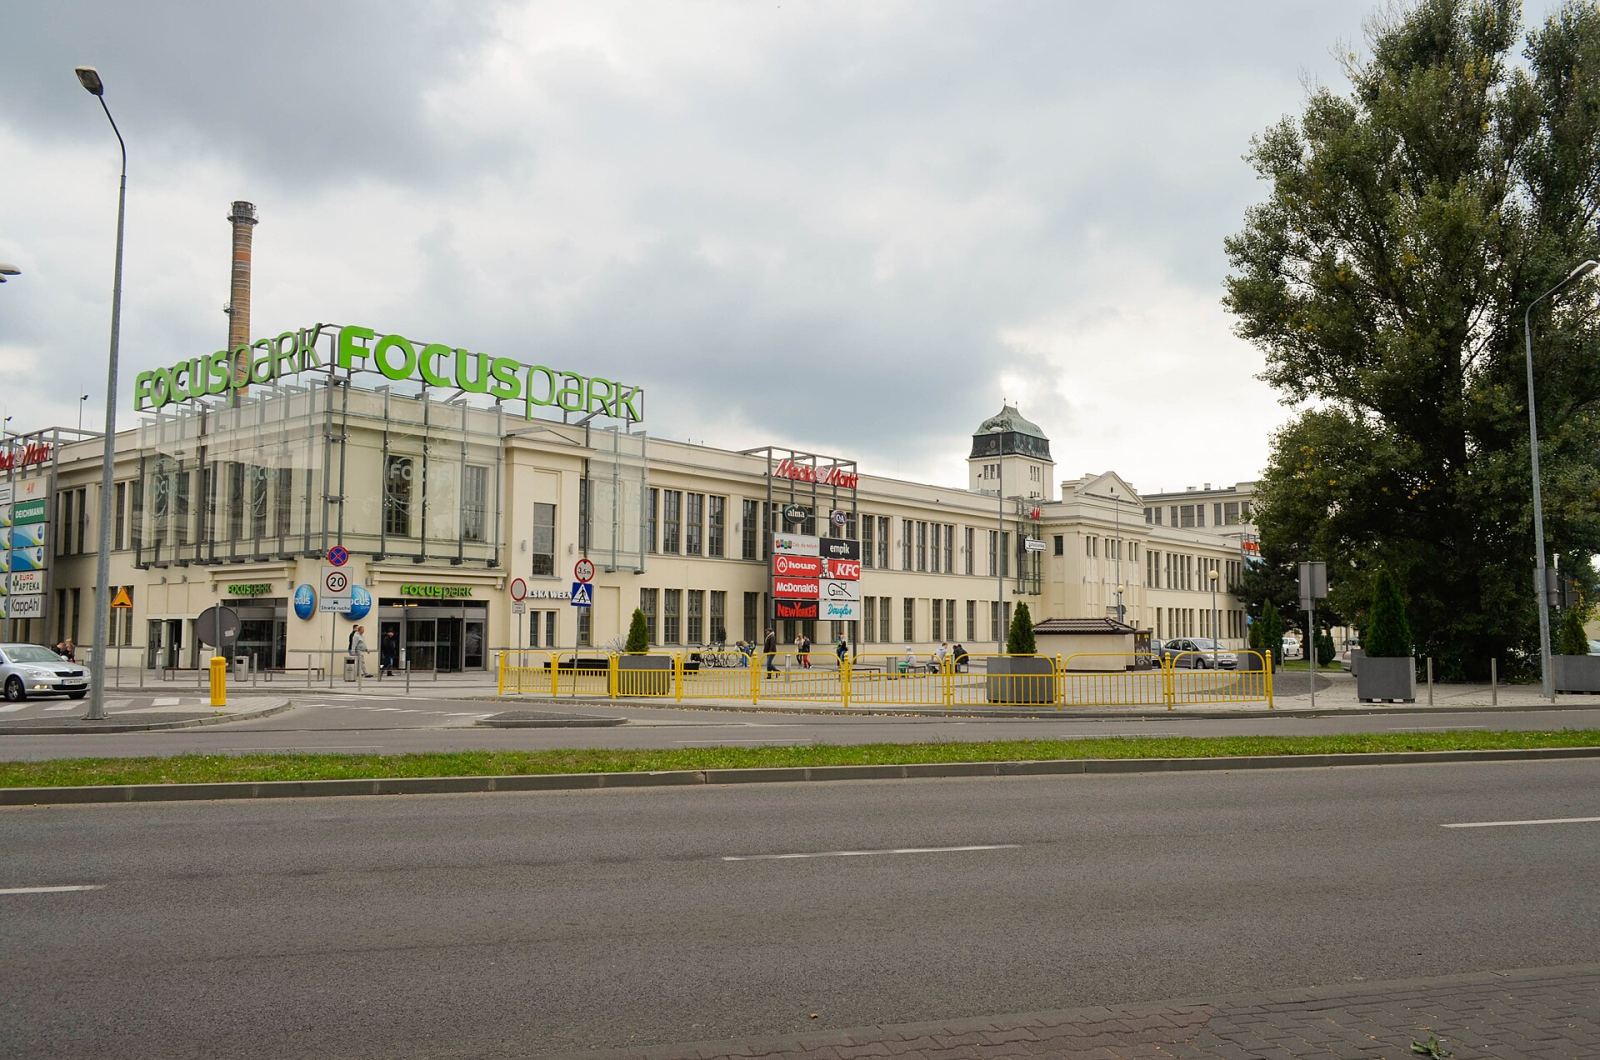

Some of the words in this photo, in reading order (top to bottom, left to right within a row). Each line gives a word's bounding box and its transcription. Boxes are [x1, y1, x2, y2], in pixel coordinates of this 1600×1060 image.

[787, 509, 805, 518] alma
[829, 542, 850, 555] empik
[788, 561, 817, 570] house
[836, 563, 859, 577] KFC
[18, 582, 40, 591] APTEKA
[330, 577, 344, 587] 20
[776, 582, 818, 593] McDonald's
[526, 590, 549, 599] LSKA
[11, 596, 40, 614] KappAhl
